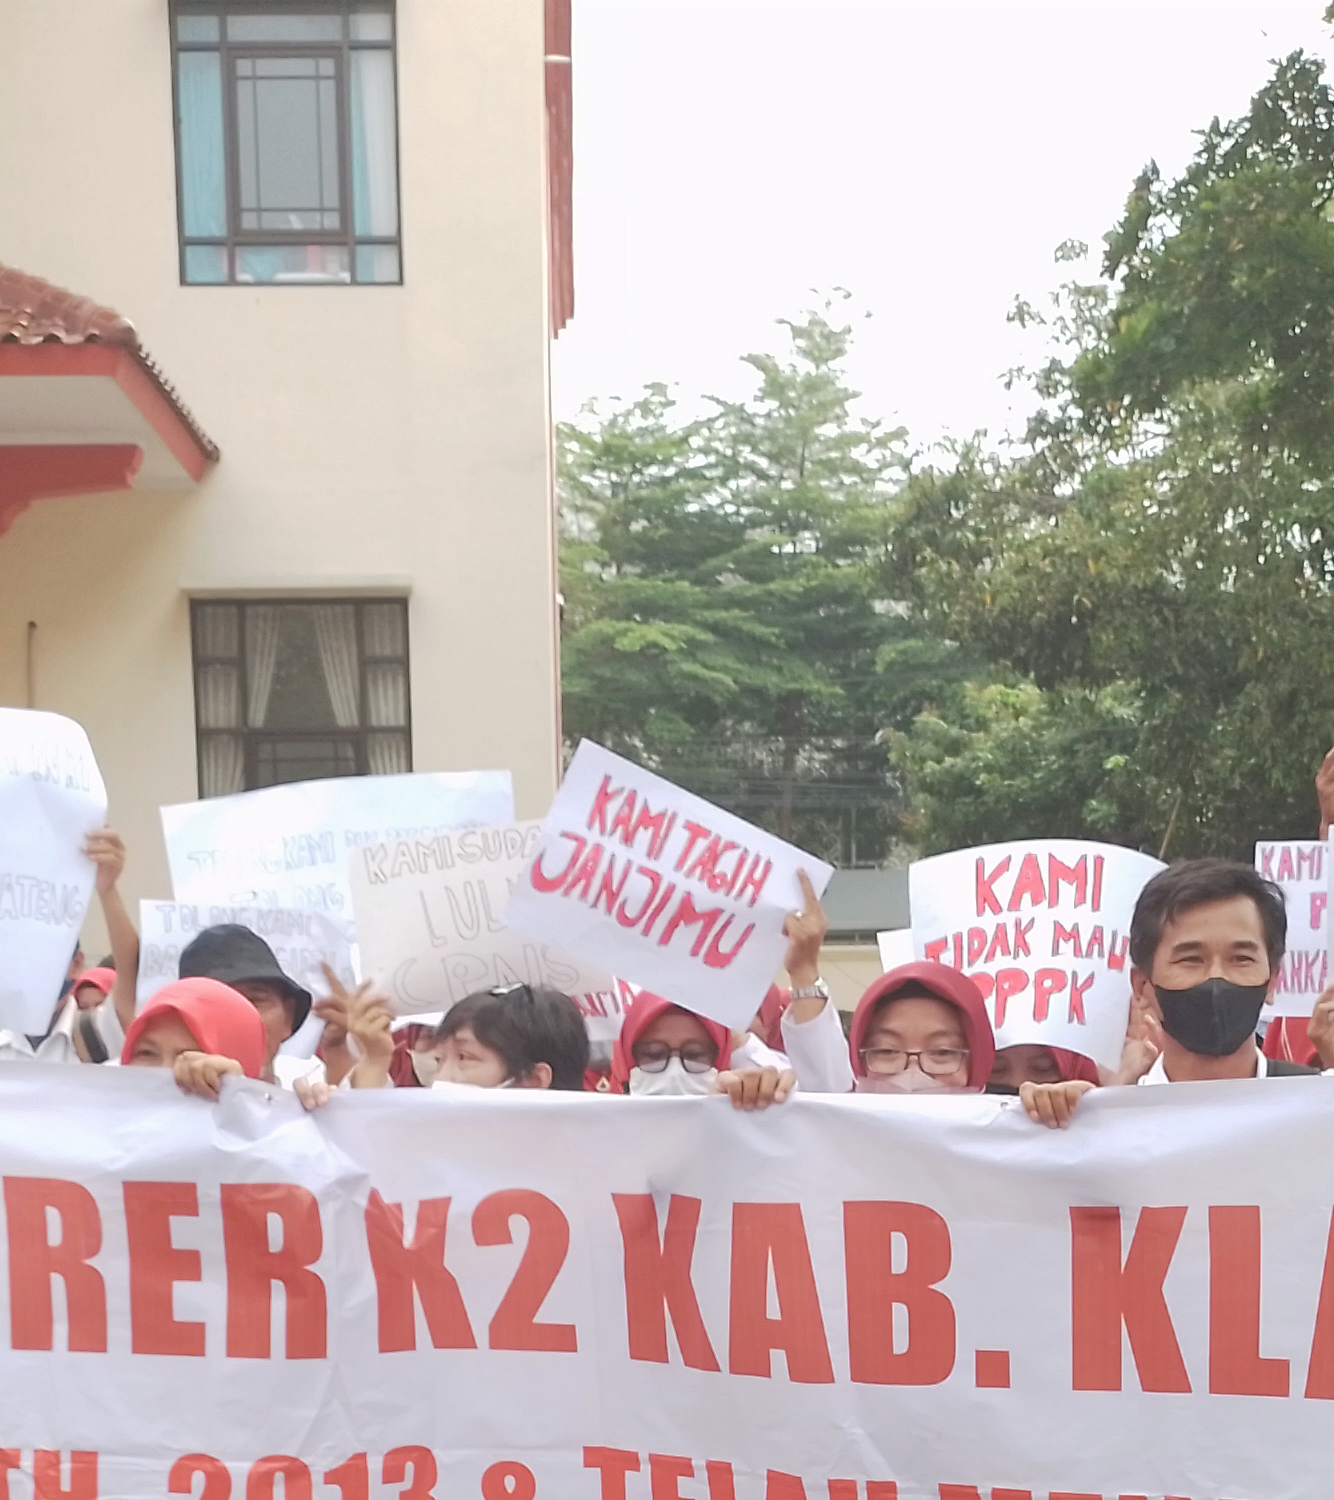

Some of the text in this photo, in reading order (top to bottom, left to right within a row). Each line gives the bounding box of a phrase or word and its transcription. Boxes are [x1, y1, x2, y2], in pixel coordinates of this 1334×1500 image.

[363, 834, 456, 886] KAMI
[456, 825, 541, 864] SUDA
[587, 773, 773, 907] KAMI TAGIH
[419, 877, 517, 949] LUL
[975, 852, 1105, 917] KAMI
[924, 916, 1129, 973] TIDAK MAU
[364, 1188, 578, 1353] K2
[612, 1193, 1010, 1388] KAB.
